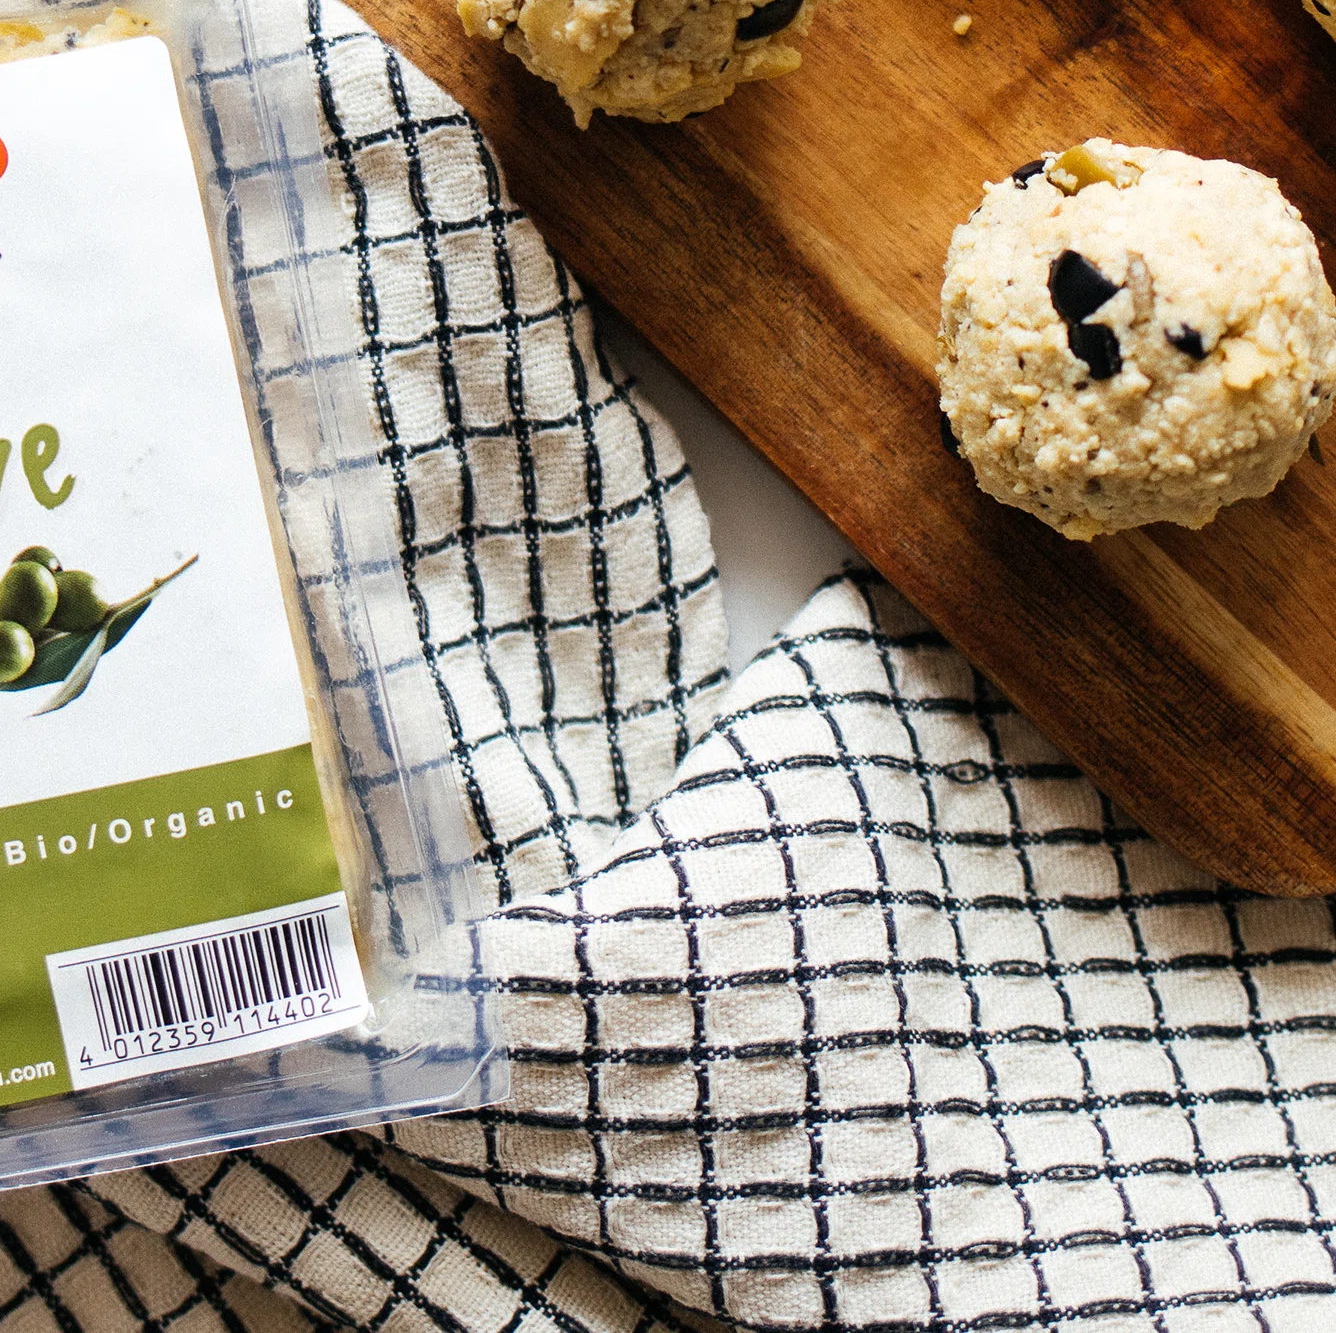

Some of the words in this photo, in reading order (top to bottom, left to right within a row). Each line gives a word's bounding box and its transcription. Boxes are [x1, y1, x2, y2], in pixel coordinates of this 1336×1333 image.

[3, 788, 294, 866] Bio/Organic
[79, 1045, 94, 1066] 4
[113, 1020, 216, 1060] 012359
[233, 992, 334, 1035] 114402
